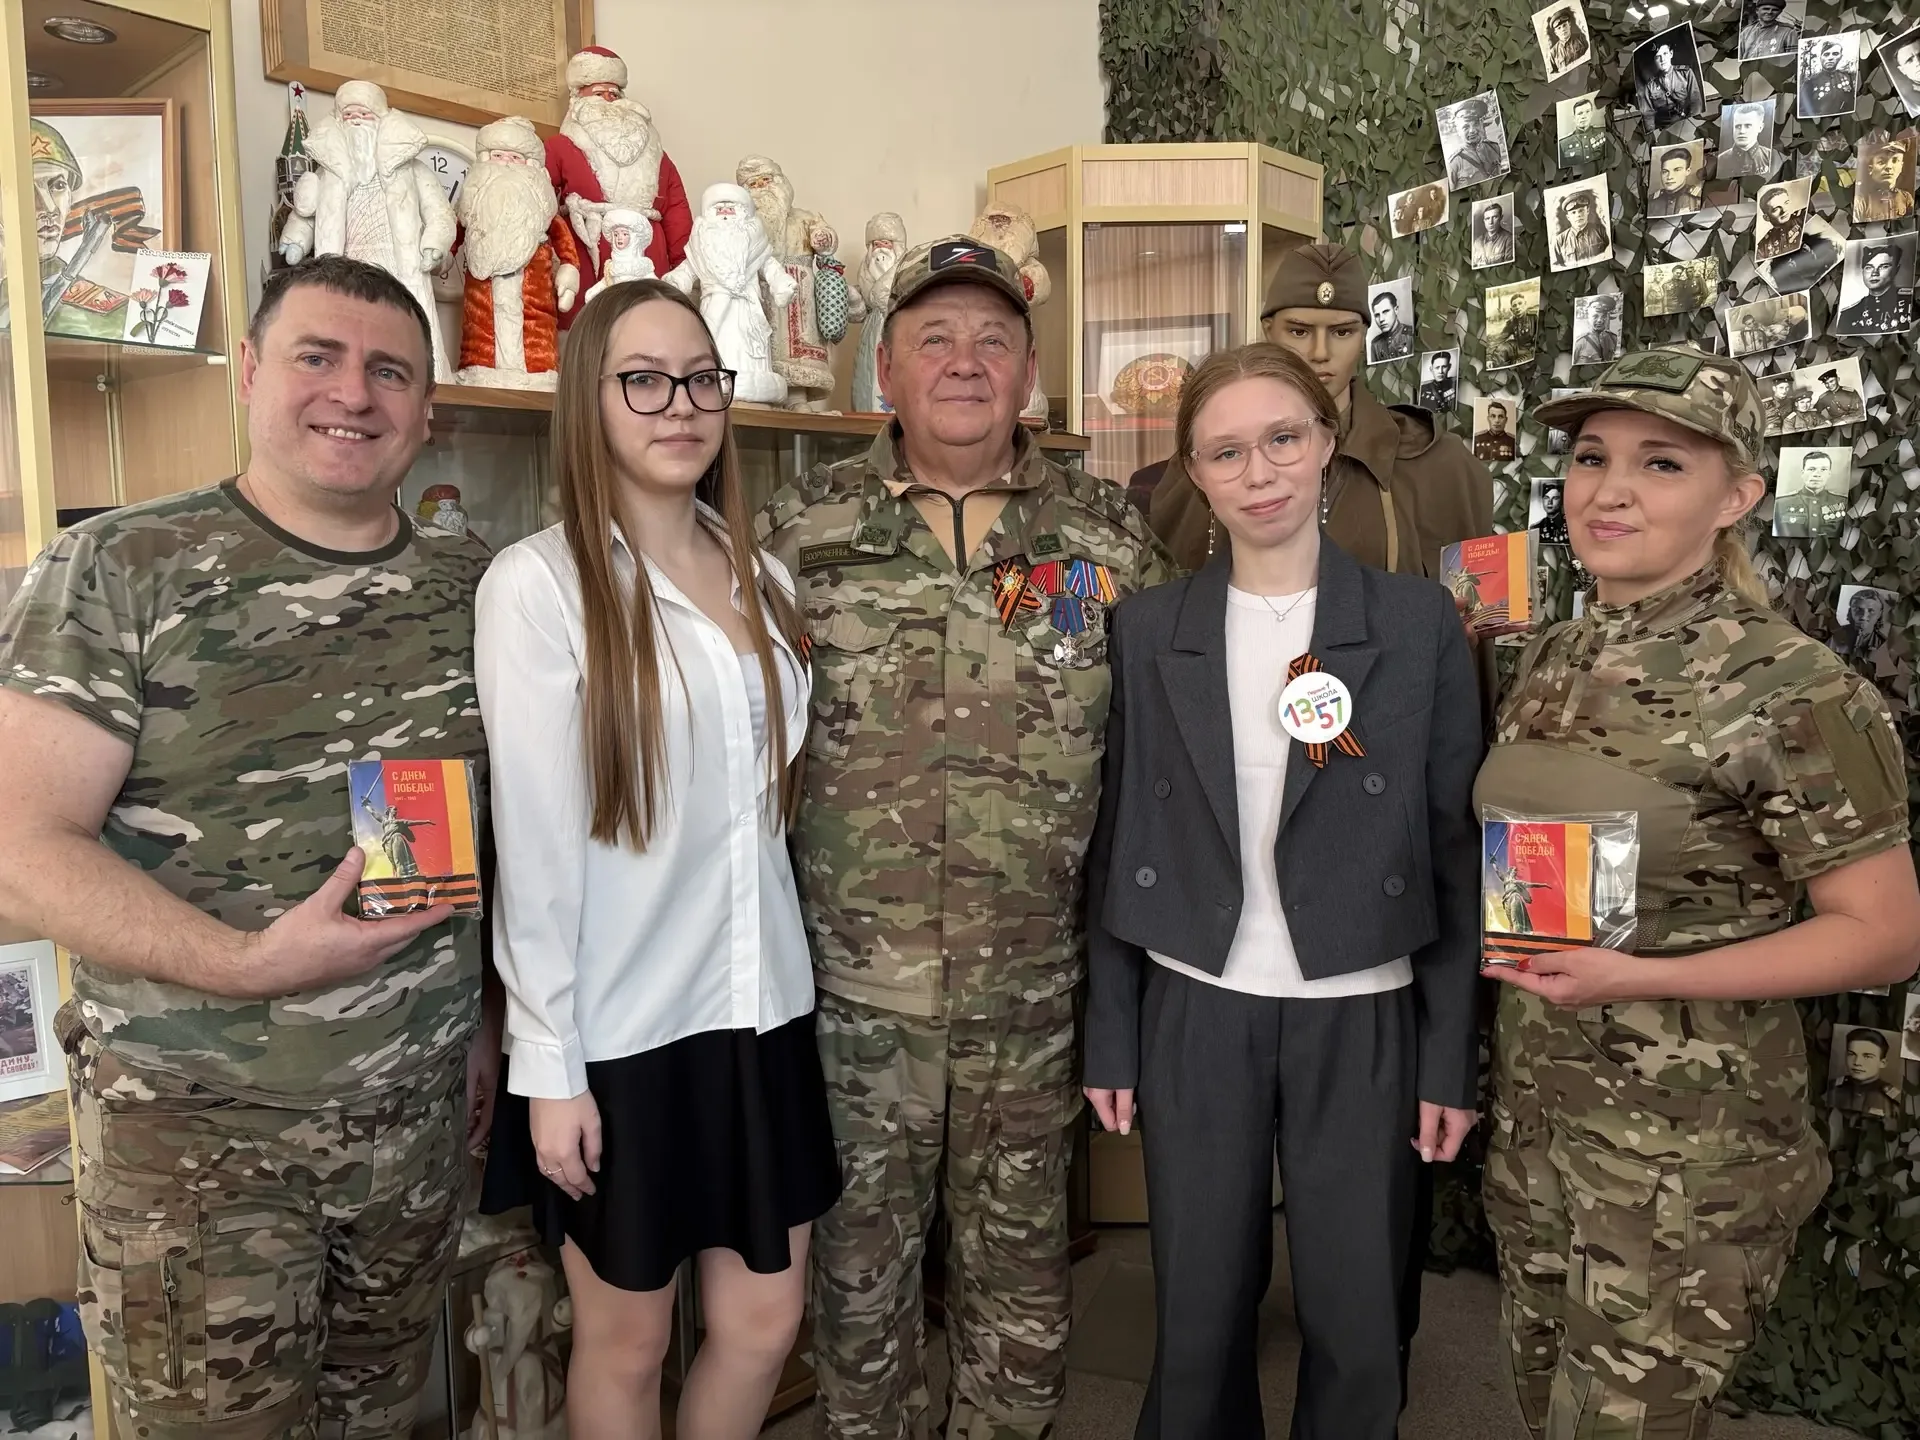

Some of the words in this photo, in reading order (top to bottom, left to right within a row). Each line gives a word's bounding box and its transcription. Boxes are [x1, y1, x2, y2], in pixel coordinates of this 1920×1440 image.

[431, 155, 448, 174] 12
[1311, 688, 1338, 703] ШКОЛА
[1284, 696, 1343, 730] 1357
[391, 771, 399, 781] С
[400, 770, 427, 782] ДНЕМ
[393, 782, 435, 794] ПОБЕДЫ!
[1515, 845, 1555, 857] ПОБЕДЫ!
